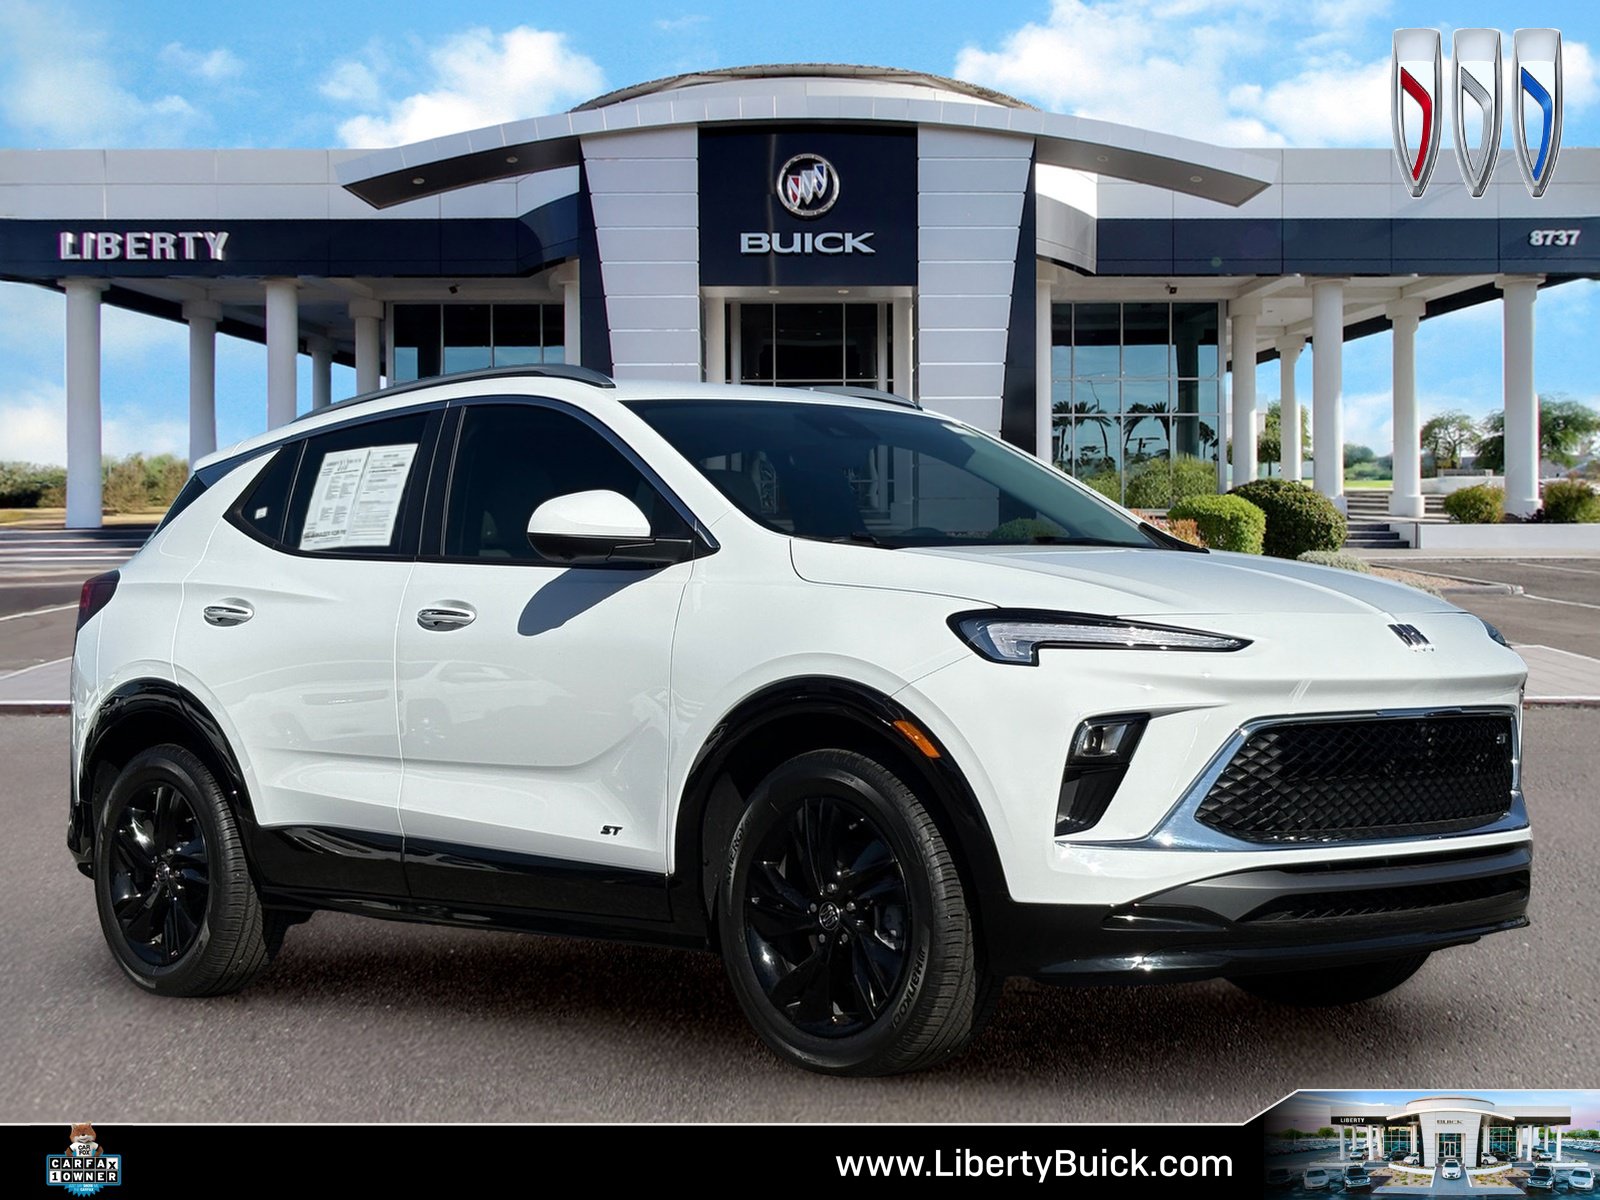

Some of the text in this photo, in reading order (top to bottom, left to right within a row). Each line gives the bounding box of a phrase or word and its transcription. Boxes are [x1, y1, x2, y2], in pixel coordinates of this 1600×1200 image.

[59, 231, 230, 261] LIBERTY
[740, 232, 876, 254] BUICK
[1529, 229, 1581, 246] 8737
[600, 824, 624, 836] ST
